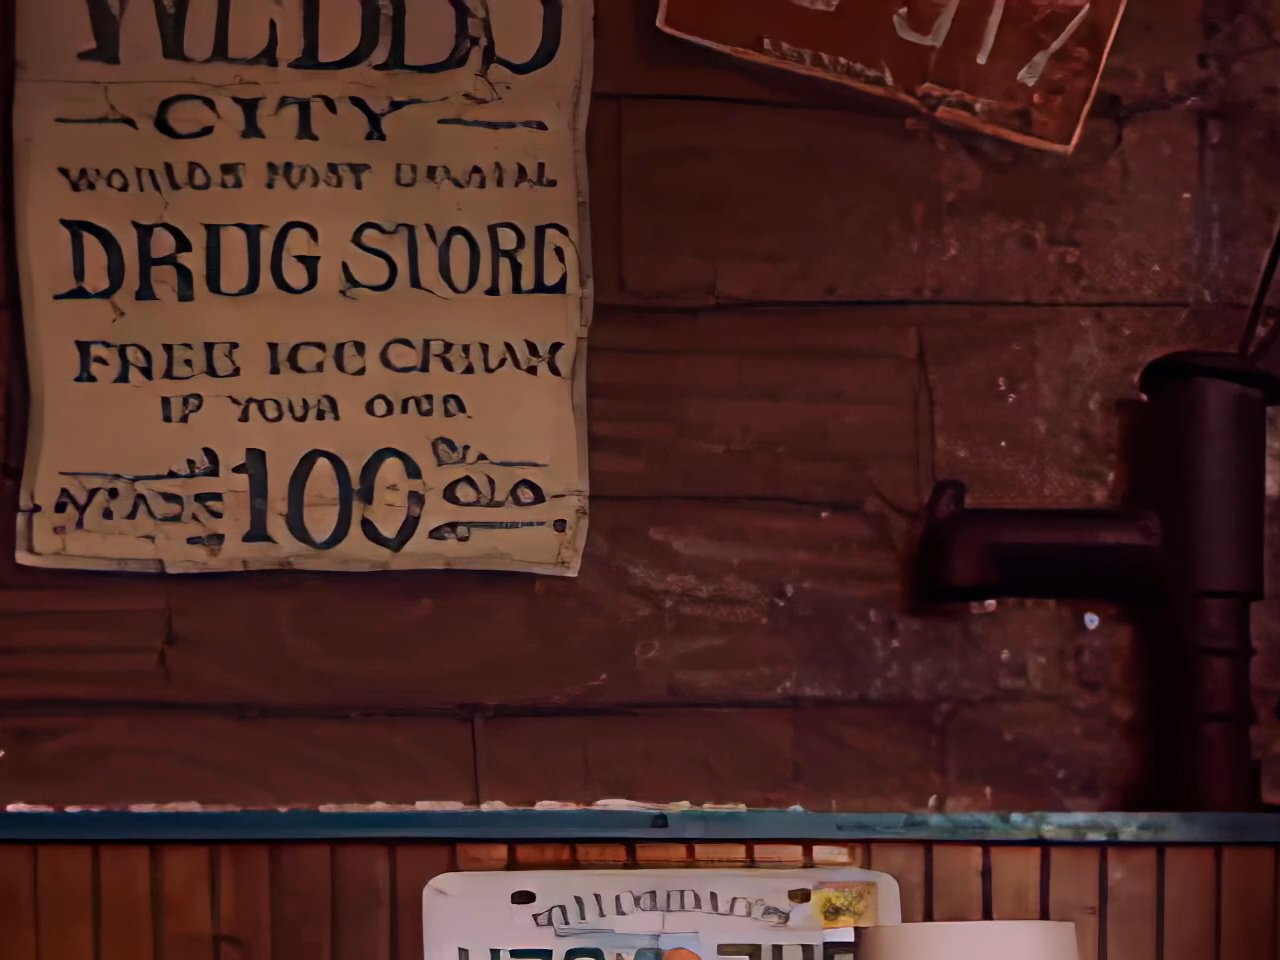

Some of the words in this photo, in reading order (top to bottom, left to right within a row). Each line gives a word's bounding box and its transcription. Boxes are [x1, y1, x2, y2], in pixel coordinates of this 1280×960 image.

[154, 93, 408, 140] CITY
[54, 219, 322, 302] DRUG
[232, 447, 426, 552] 100
